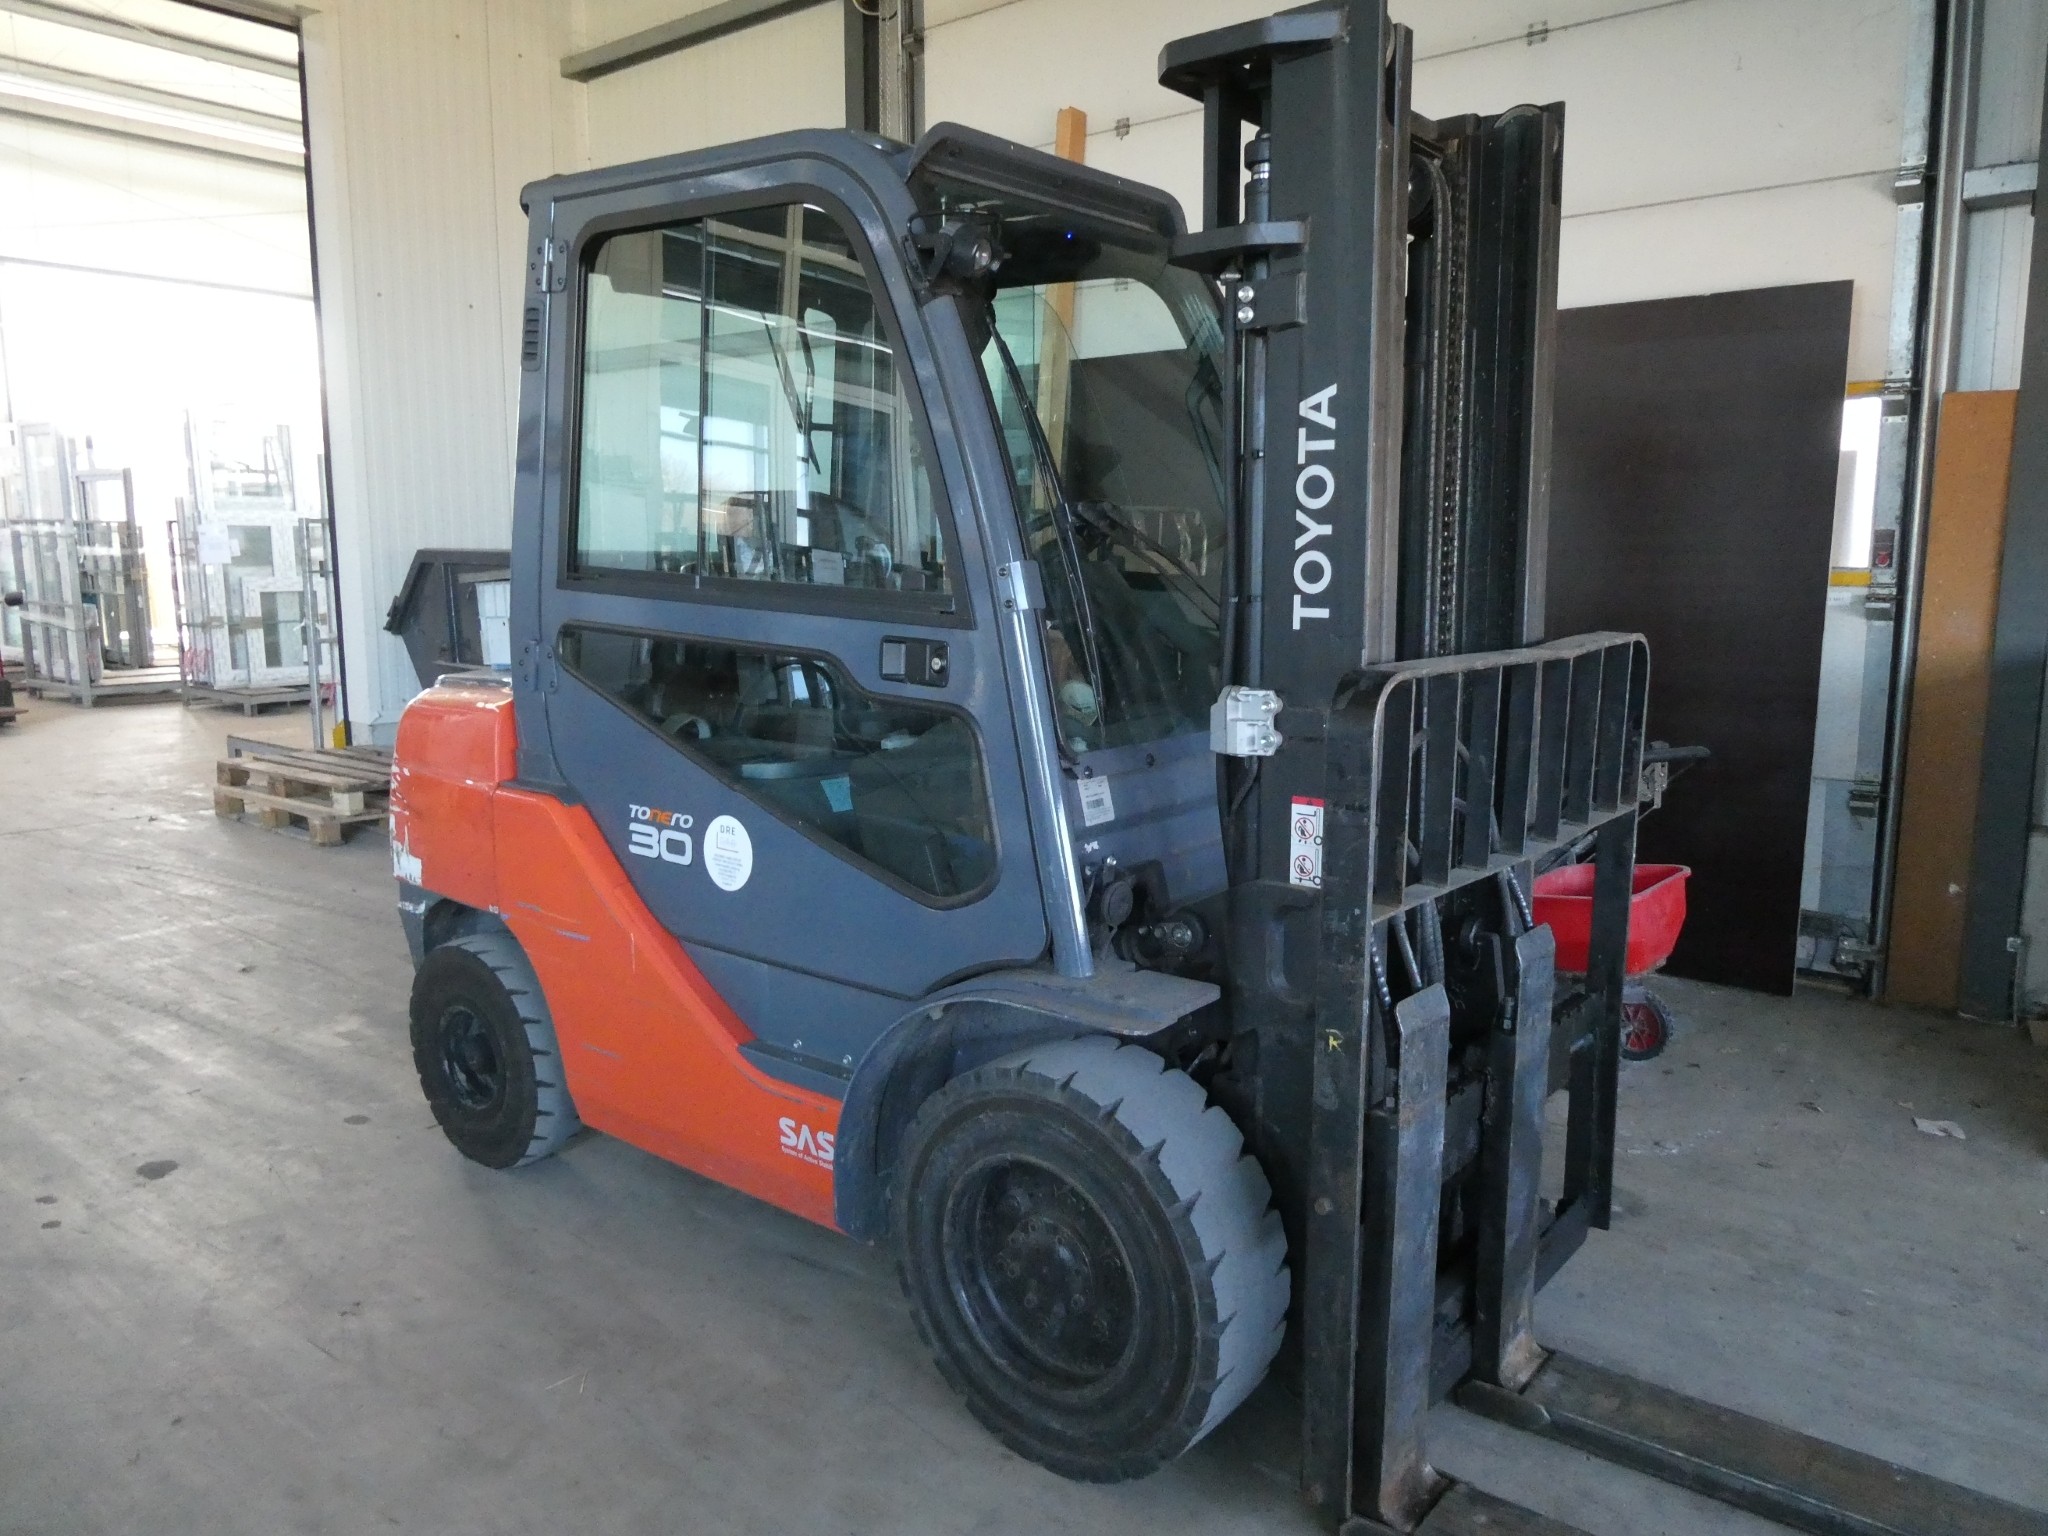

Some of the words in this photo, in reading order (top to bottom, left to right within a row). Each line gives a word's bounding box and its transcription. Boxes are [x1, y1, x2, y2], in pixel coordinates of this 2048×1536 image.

[1293, 383, 1337, 630] TOYOTA
[628, 822, 693, 866] 30
[779, 1117, 834, 1161] SAS
